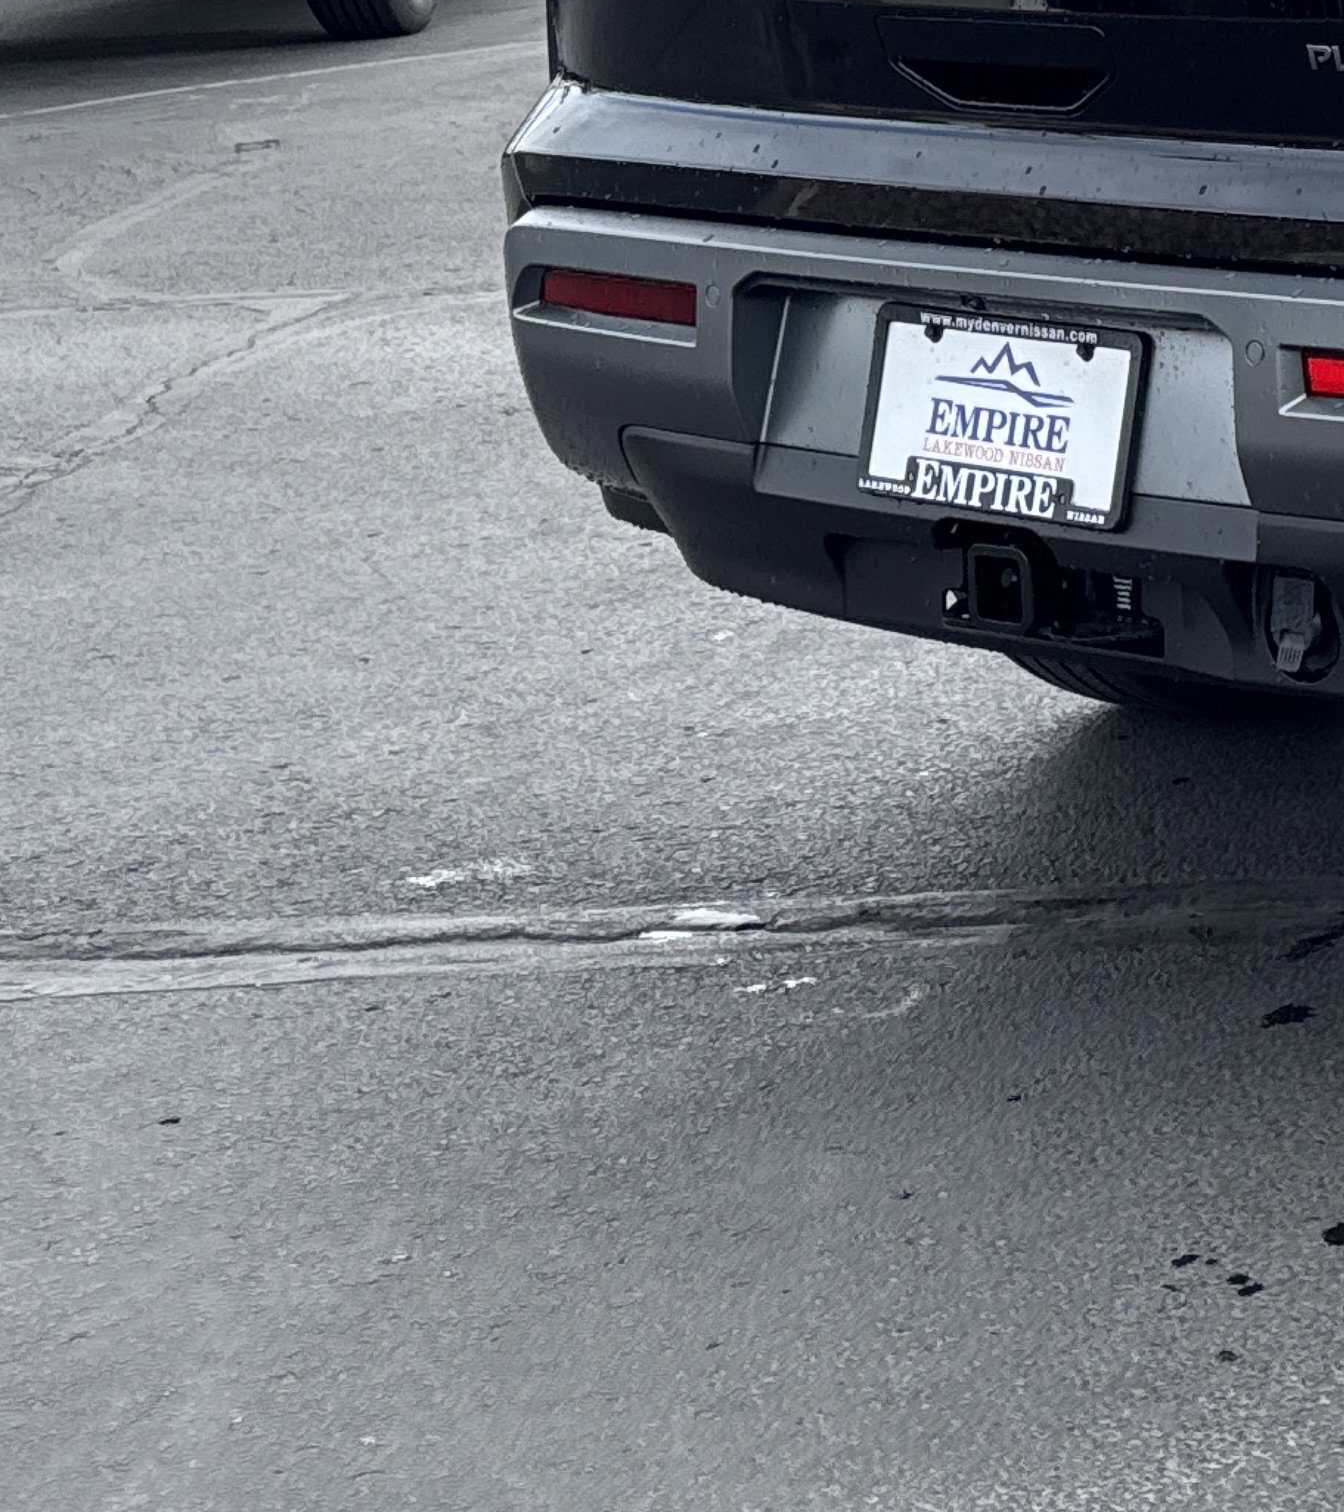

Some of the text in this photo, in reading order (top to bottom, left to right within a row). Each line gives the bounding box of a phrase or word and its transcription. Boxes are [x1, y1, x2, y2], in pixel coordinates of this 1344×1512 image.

[920, 312, 1098, 345] www.mydenvernissan.com
[925, 396, 1071, 454] EMPIRE
[922, 437, 1066, 473] LAKEWOOD NISSAN
[911, 458, 1057, 519] EMPIRE
